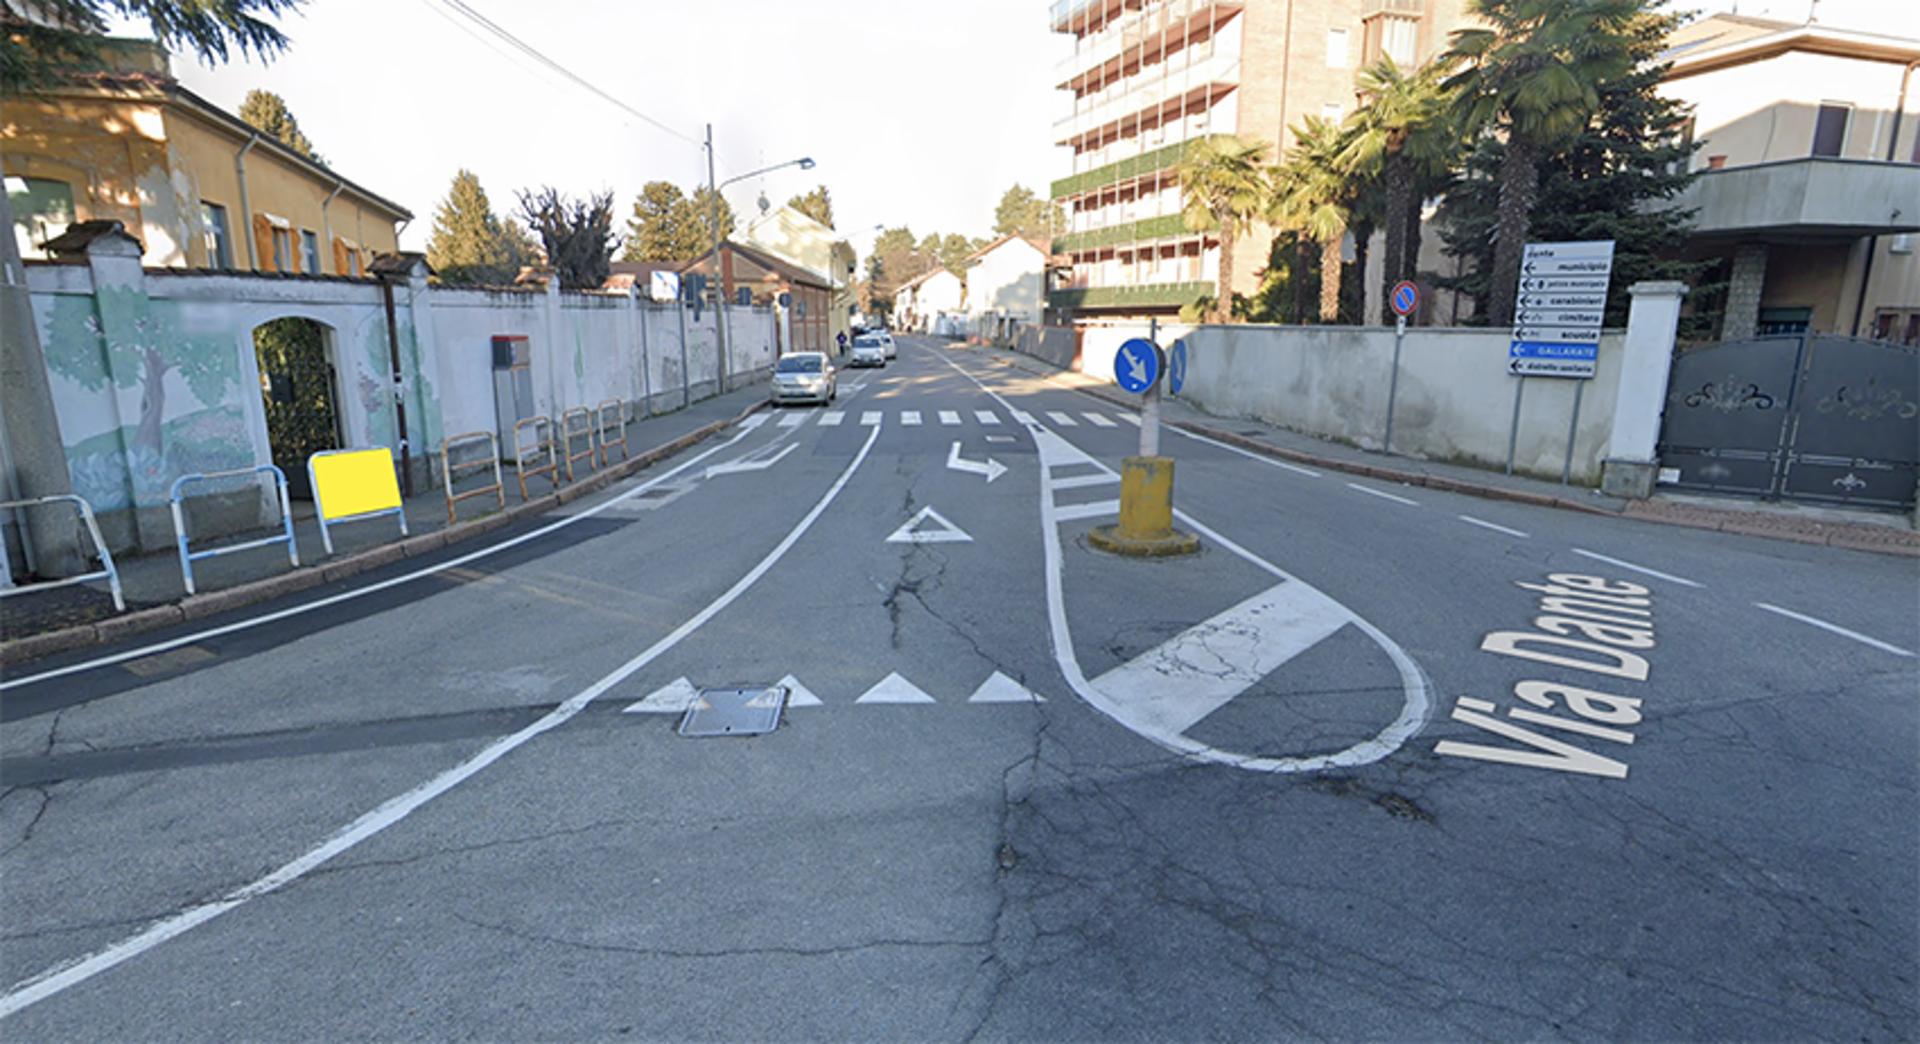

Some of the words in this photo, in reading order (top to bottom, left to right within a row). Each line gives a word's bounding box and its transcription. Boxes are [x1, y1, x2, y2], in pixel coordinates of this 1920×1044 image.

[1557, 261, 1608, 272] municipio
[1550, 296, 1602, 305] carabinieri
[1537, 346, 1595, 357] GALLARATE
[1481, 573, 1654, 681] Dante
[1434, 680, 1642, 778] Via
